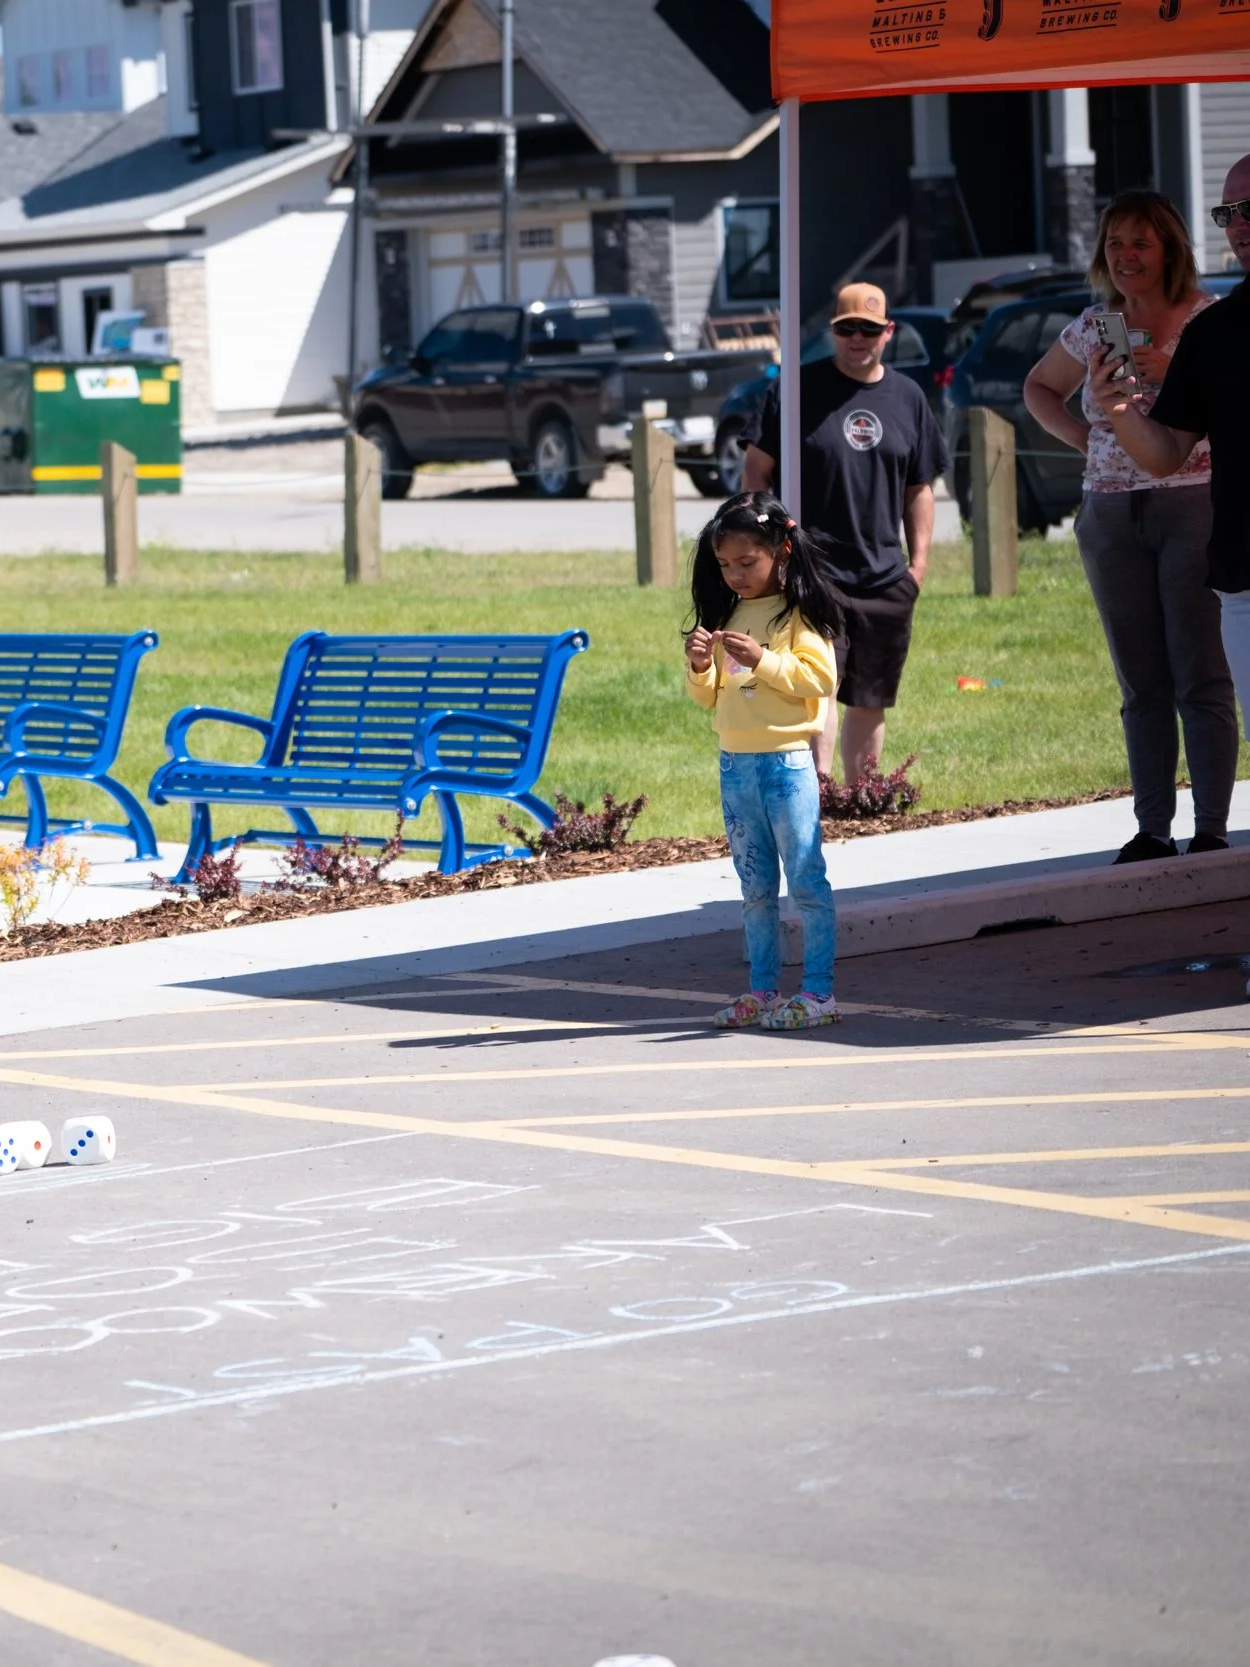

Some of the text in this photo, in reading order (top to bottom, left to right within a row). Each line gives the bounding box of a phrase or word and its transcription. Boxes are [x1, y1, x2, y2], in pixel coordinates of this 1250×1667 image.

[871, 7, 947, 28] MALTING &
[1039, 9, 1118, 28] BREWING CO.
[869, 29, 940, 49] BREWING CO.
[69, 1177, 542, 1252] BIG
[123, 1279, 849, 1402] GO PAST
